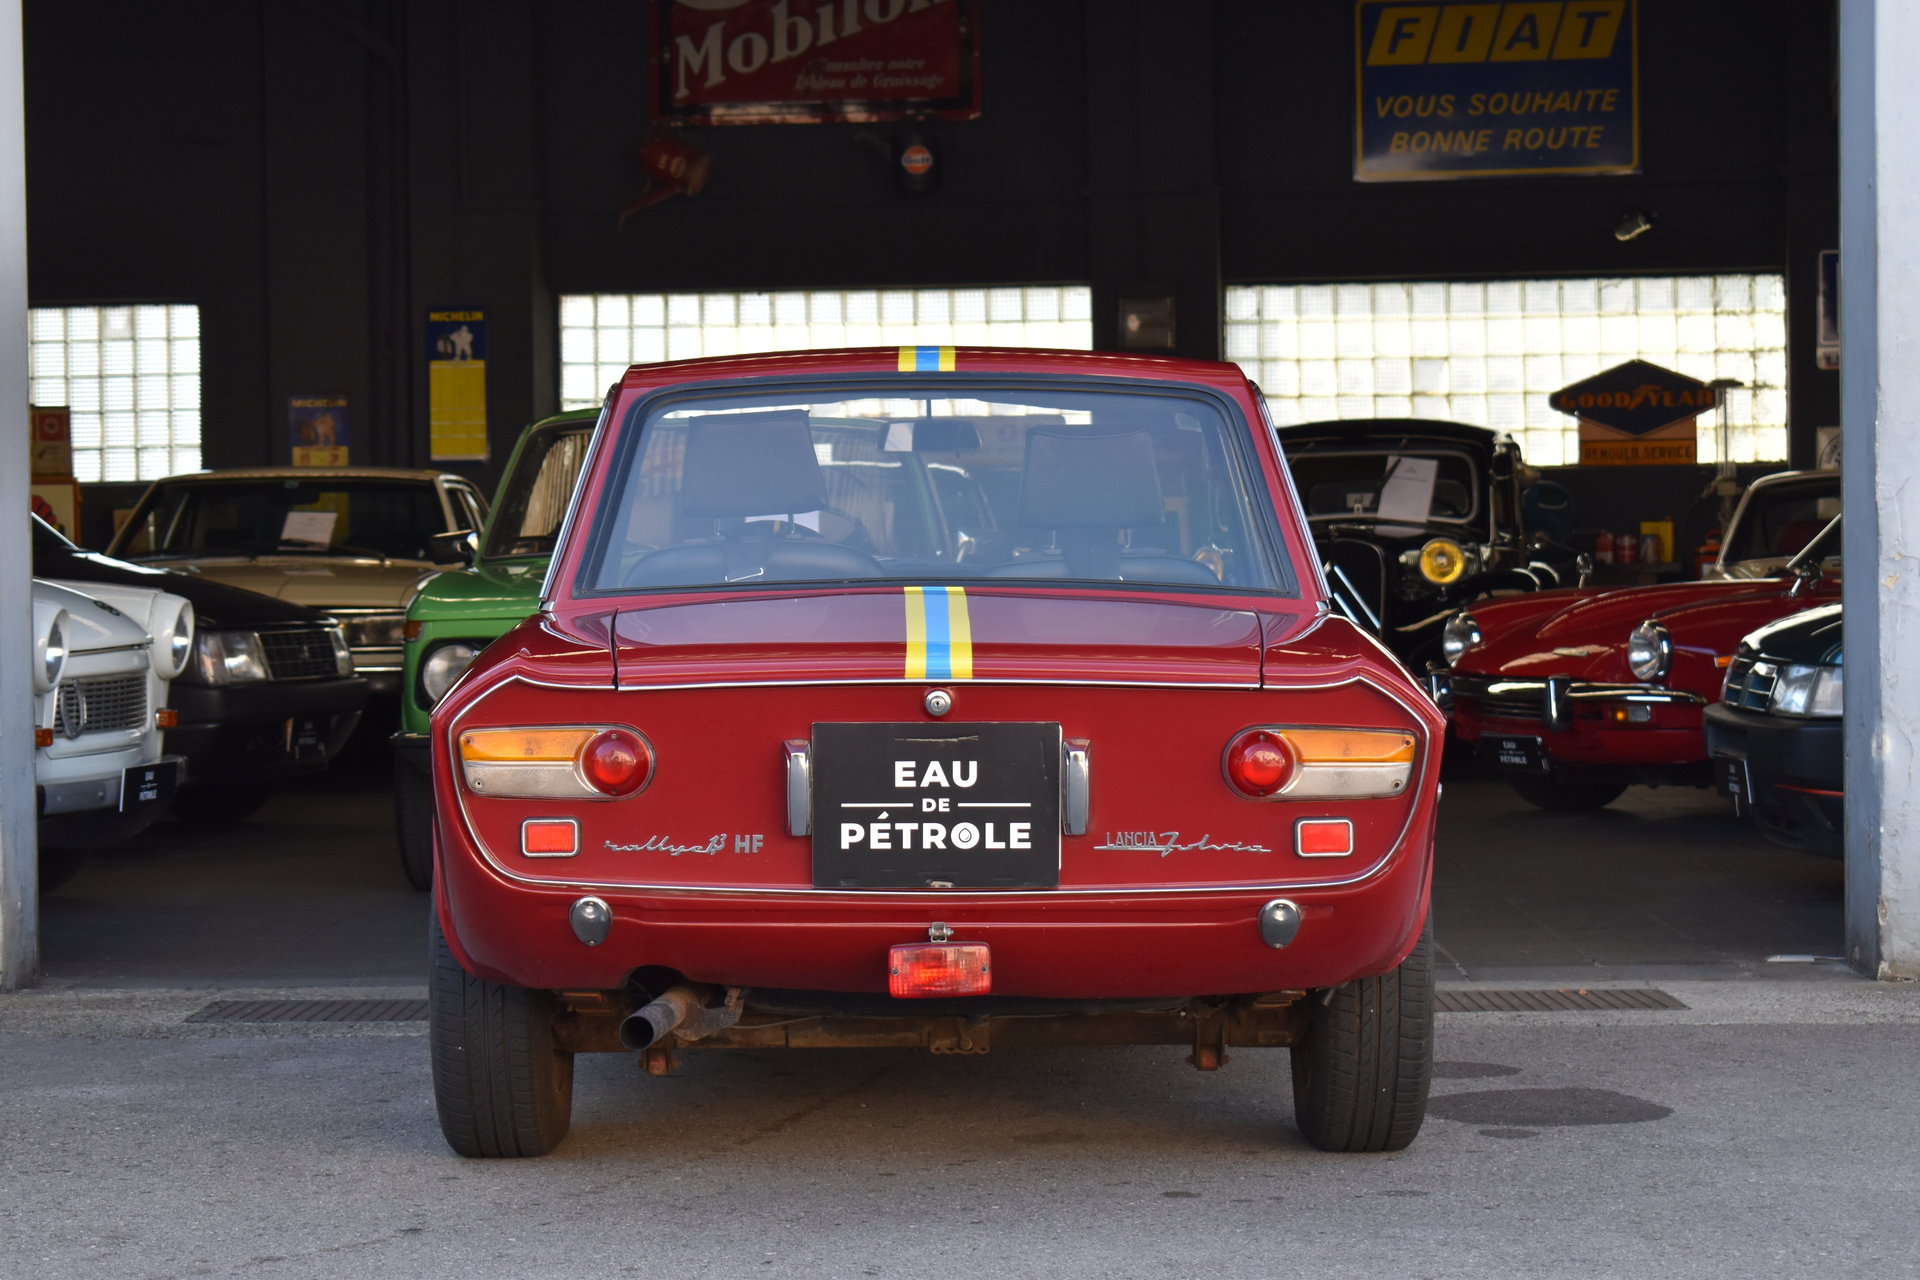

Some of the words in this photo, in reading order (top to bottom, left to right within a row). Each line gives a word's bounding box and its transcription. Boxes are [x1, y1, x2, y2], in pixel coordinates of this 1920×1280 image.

[1387, 11, 1610, 55] FIAT
[1375, 93, 1457, 118] VOUS
[1467, 88, 1620, 116] SOUHAITE
[1389, 130, 1493, 153] BONNE
[1502, 126, 1605, 150] ROUTE
[429, 311, 484, 322] MICHELIN
[1560, 385, 1713, 410] GOODYEAR
[1642, 446, 1692, 460] SERVICE
[894, 760, 978, 788] EAU
[921, 798, 951, 812] DE
[734, 834, 764, 853] HF
[840, 810, 1032, 850] PÉTROLE
[1105, 831, 1158, 848] LANCIA
[1160, 831, 1272, 858] Fulvia
